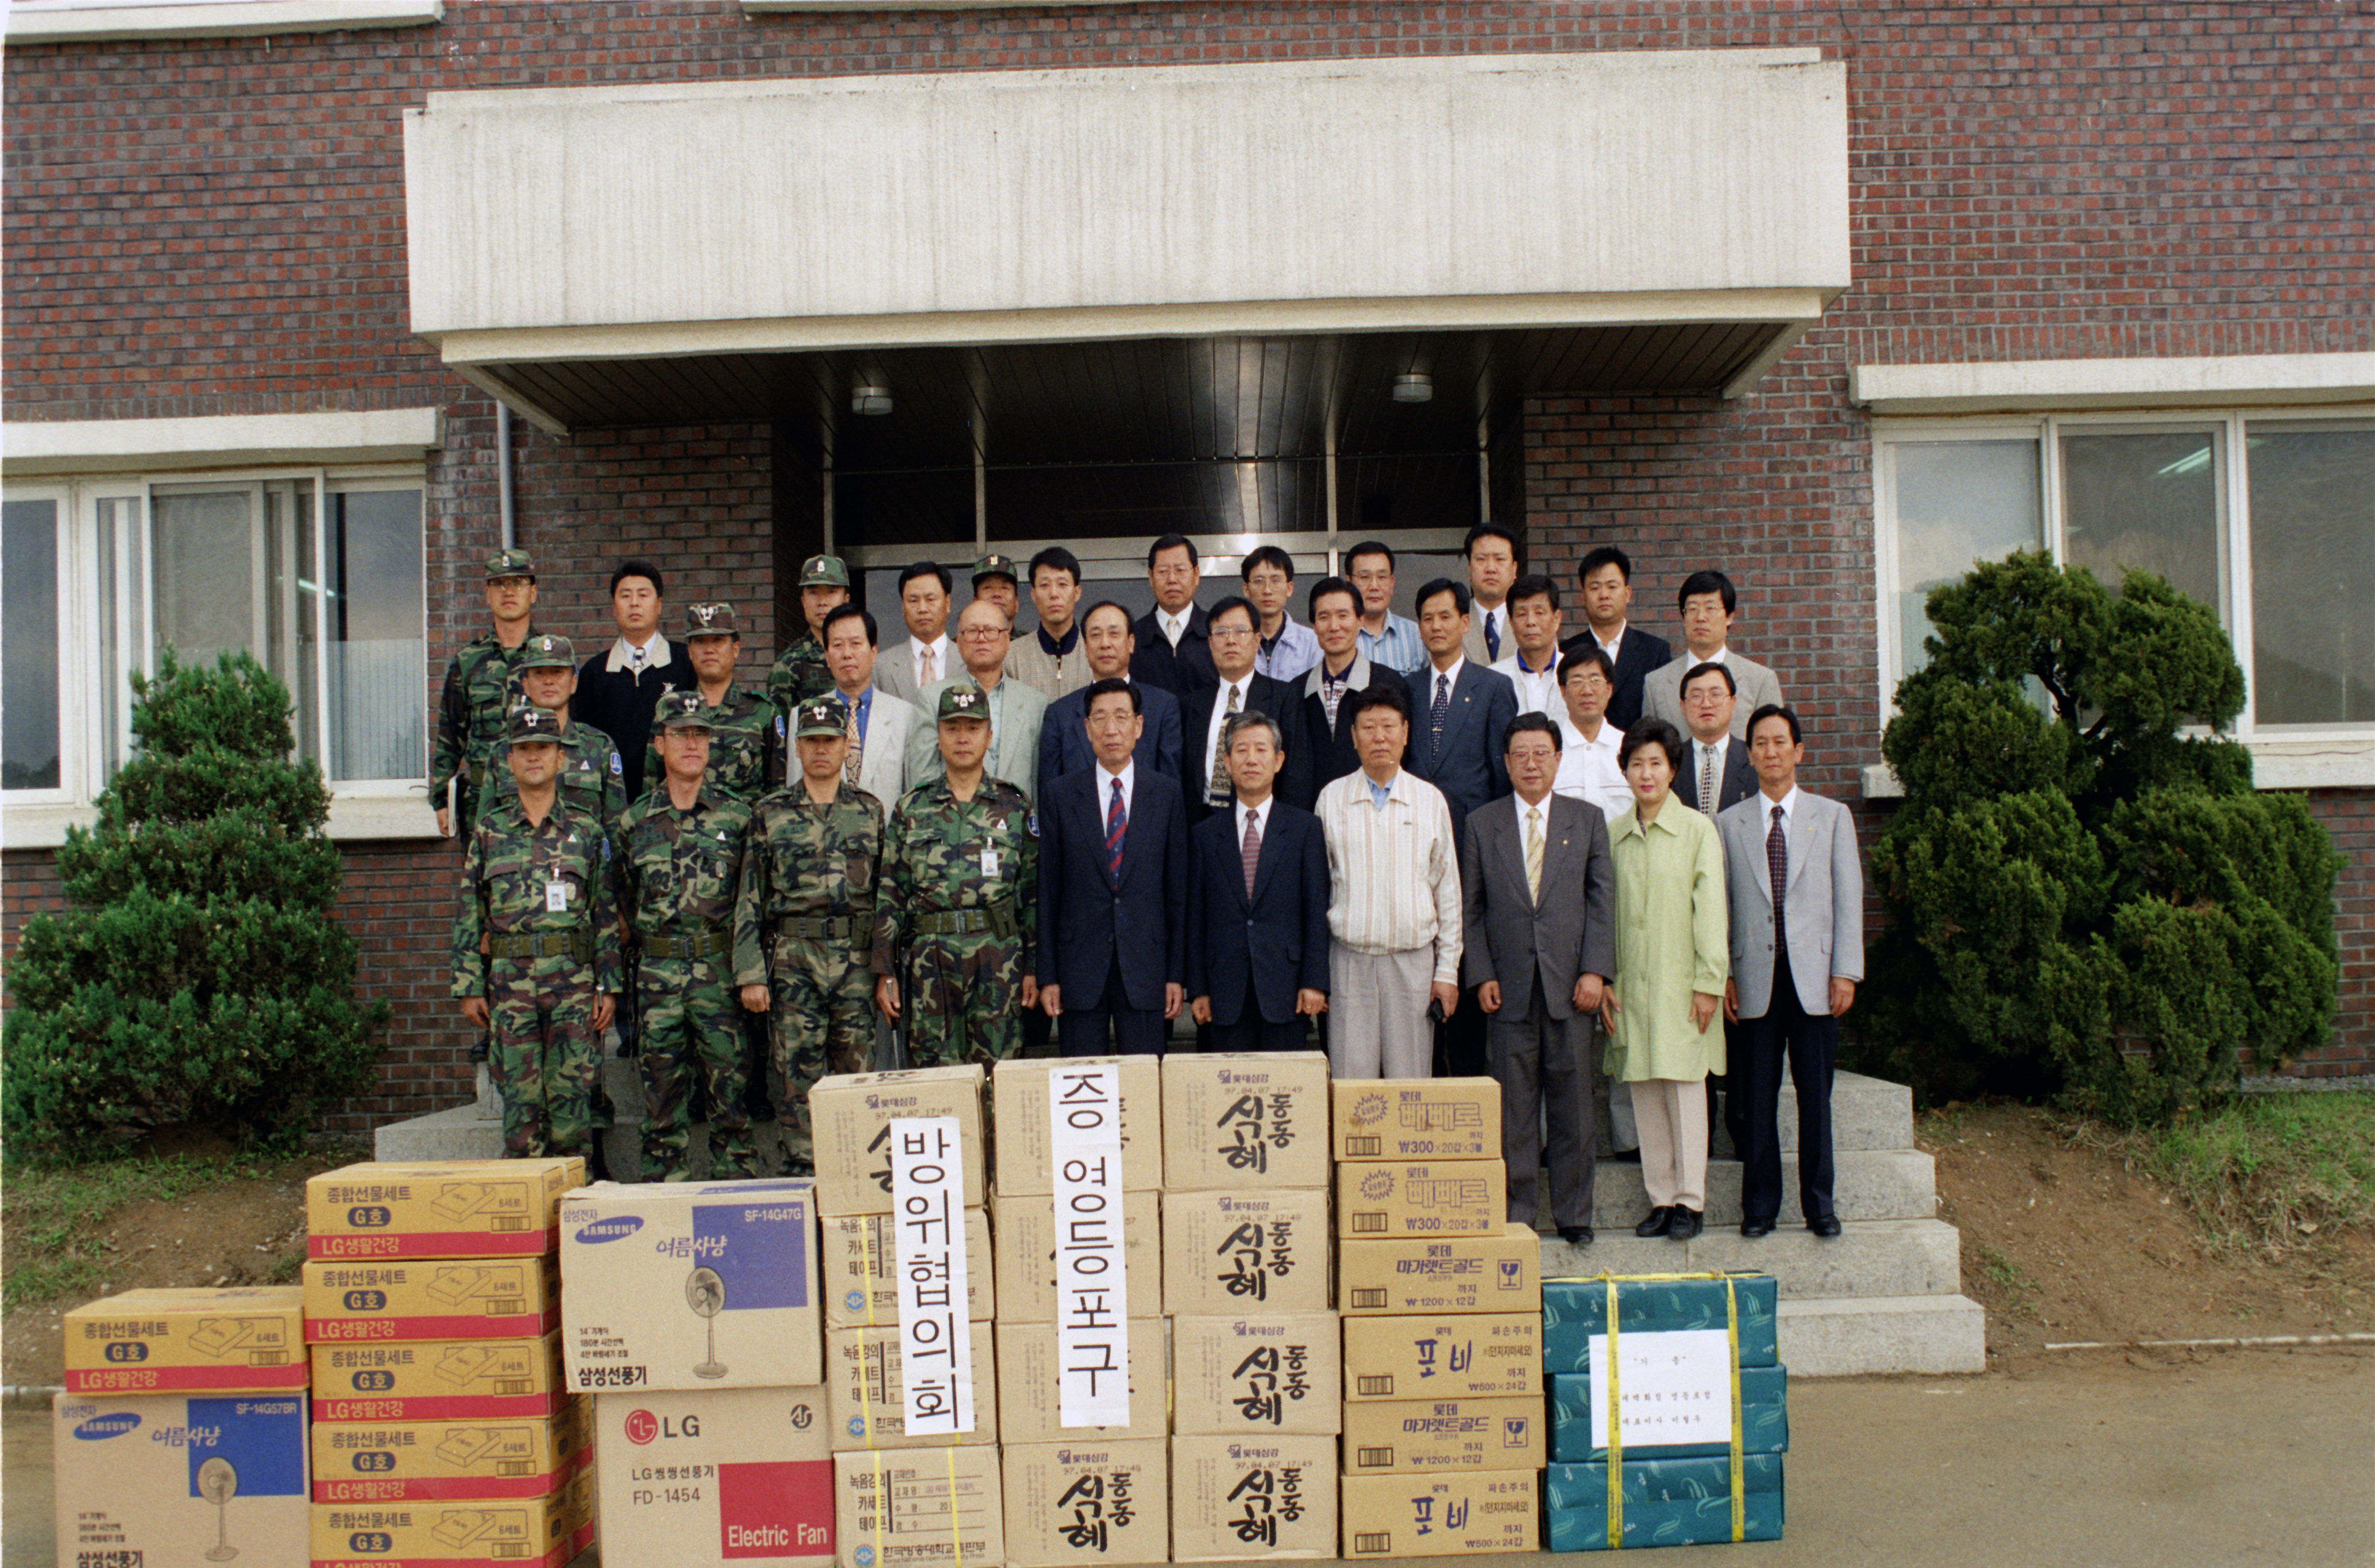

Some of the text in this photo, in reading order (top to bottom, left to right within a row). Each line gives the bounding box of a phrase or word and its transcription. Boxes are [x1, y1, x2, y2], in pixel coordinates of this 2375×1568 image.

[1400, 1091, 1421, 1102] 롯데
[1267, 1094, 1295, 1148] 동동
[1398, 1102, 1483, 1131] 빼빼로
[1217, 1095, 1266, 1174] 식혜
[1407, 1167, 1428, 1177] 롯데
[327, 1187, 411, 1203] 종합선물세트
[1405, 1179, 1489, 1208] 빼빼로
[354, 1209, 384, 1225] G호
[563, 1209, 598, 1222] 삼성전자
[744, 1208, 802, 1222] SF-14G47G
[584, 1224, 637, 1236] SAMSUNG
[840, 1218, 876, 1233] 녹음의
[1060, 1074, 1118, 1397] 증 영등포구
[322, 1237, 400, 1255] LG생활건강
[656, 1235, 728, 1258] 여름사냥
[1267, 1222, 1295, 1276] 동동
[1427, 1245, 1452, 1257] 롯데
[1217, 1222, 1266, 1301] 식혜
[1396, 1258, 1484, 1274] 마가렛트골드
[323, 1270, 407, 1287] 종합선물세트
[903, 1128, 959, 1429] 방위협의회
[1458, 1284, 1477, 1293] 까지
[350, 1293, 380, 1308] G호
[84, 1322, 169, 1338] 종합선물세트
[318, 1322, 395, 1338] LG생활건강
[1492, 1326, 1532, 1335] 파손주의
[111, 1345, 140, 1360] G호
[332, 1351, 415, 1368] 종합선물세트
[1415, 1339, 1472, 1378] 포비
[80, 1371, 158, 1389] LG생활건강
[359, 1373, 388, 1388] G호
[578, 1365, 647, 1387] 삼성선풍기
[1283, 1346, 1311, 1400] 동동
[1507, 1368, 1526, 1377] 까지
[1233, 1346, 1281, 1426] 식혜
[327, 1401, 403, 1419] LG생활건강
[1434, 1403, 1458, 1415] 롯데
[82, 1421, 134, 1432] SAMSUNG
[663, 1415, 701, 1438] LG
[1403, 1416, 1490, 1432] 마가렛트골드
[152, 1426, 222, 1447] 여름사냥
[332, 1432, 416, 1449] 종합선물세트
[1464, 1442, 1482, 1451] 까지
[359, 1454, 389, 1470] G호
[327, 1482, 406, 1500] LG생활건강
[1277, 1468, 1305, 1521] 동동
[1488, 1482, 1528, 1493] 파손주의
[634, 1488, 701, 1505] FD-1454
[1107, 1473, 1136, 1527] 동동
[1057, 1474, 1107, 1552] 식혜
[1227, 1469, 1276, 1547] 식혜
[1411, 1496, 1469, 1535] 포비
[329, 1513, 412, 1529] 종합선물세트
[1503, 1524, 1522, 1534] 까지
[356, 1535, 385, 1551] G호
[728, 1523, 828, 1547] Electric Fan
[77, 1550, 143, 1568] 삼성선풍기
